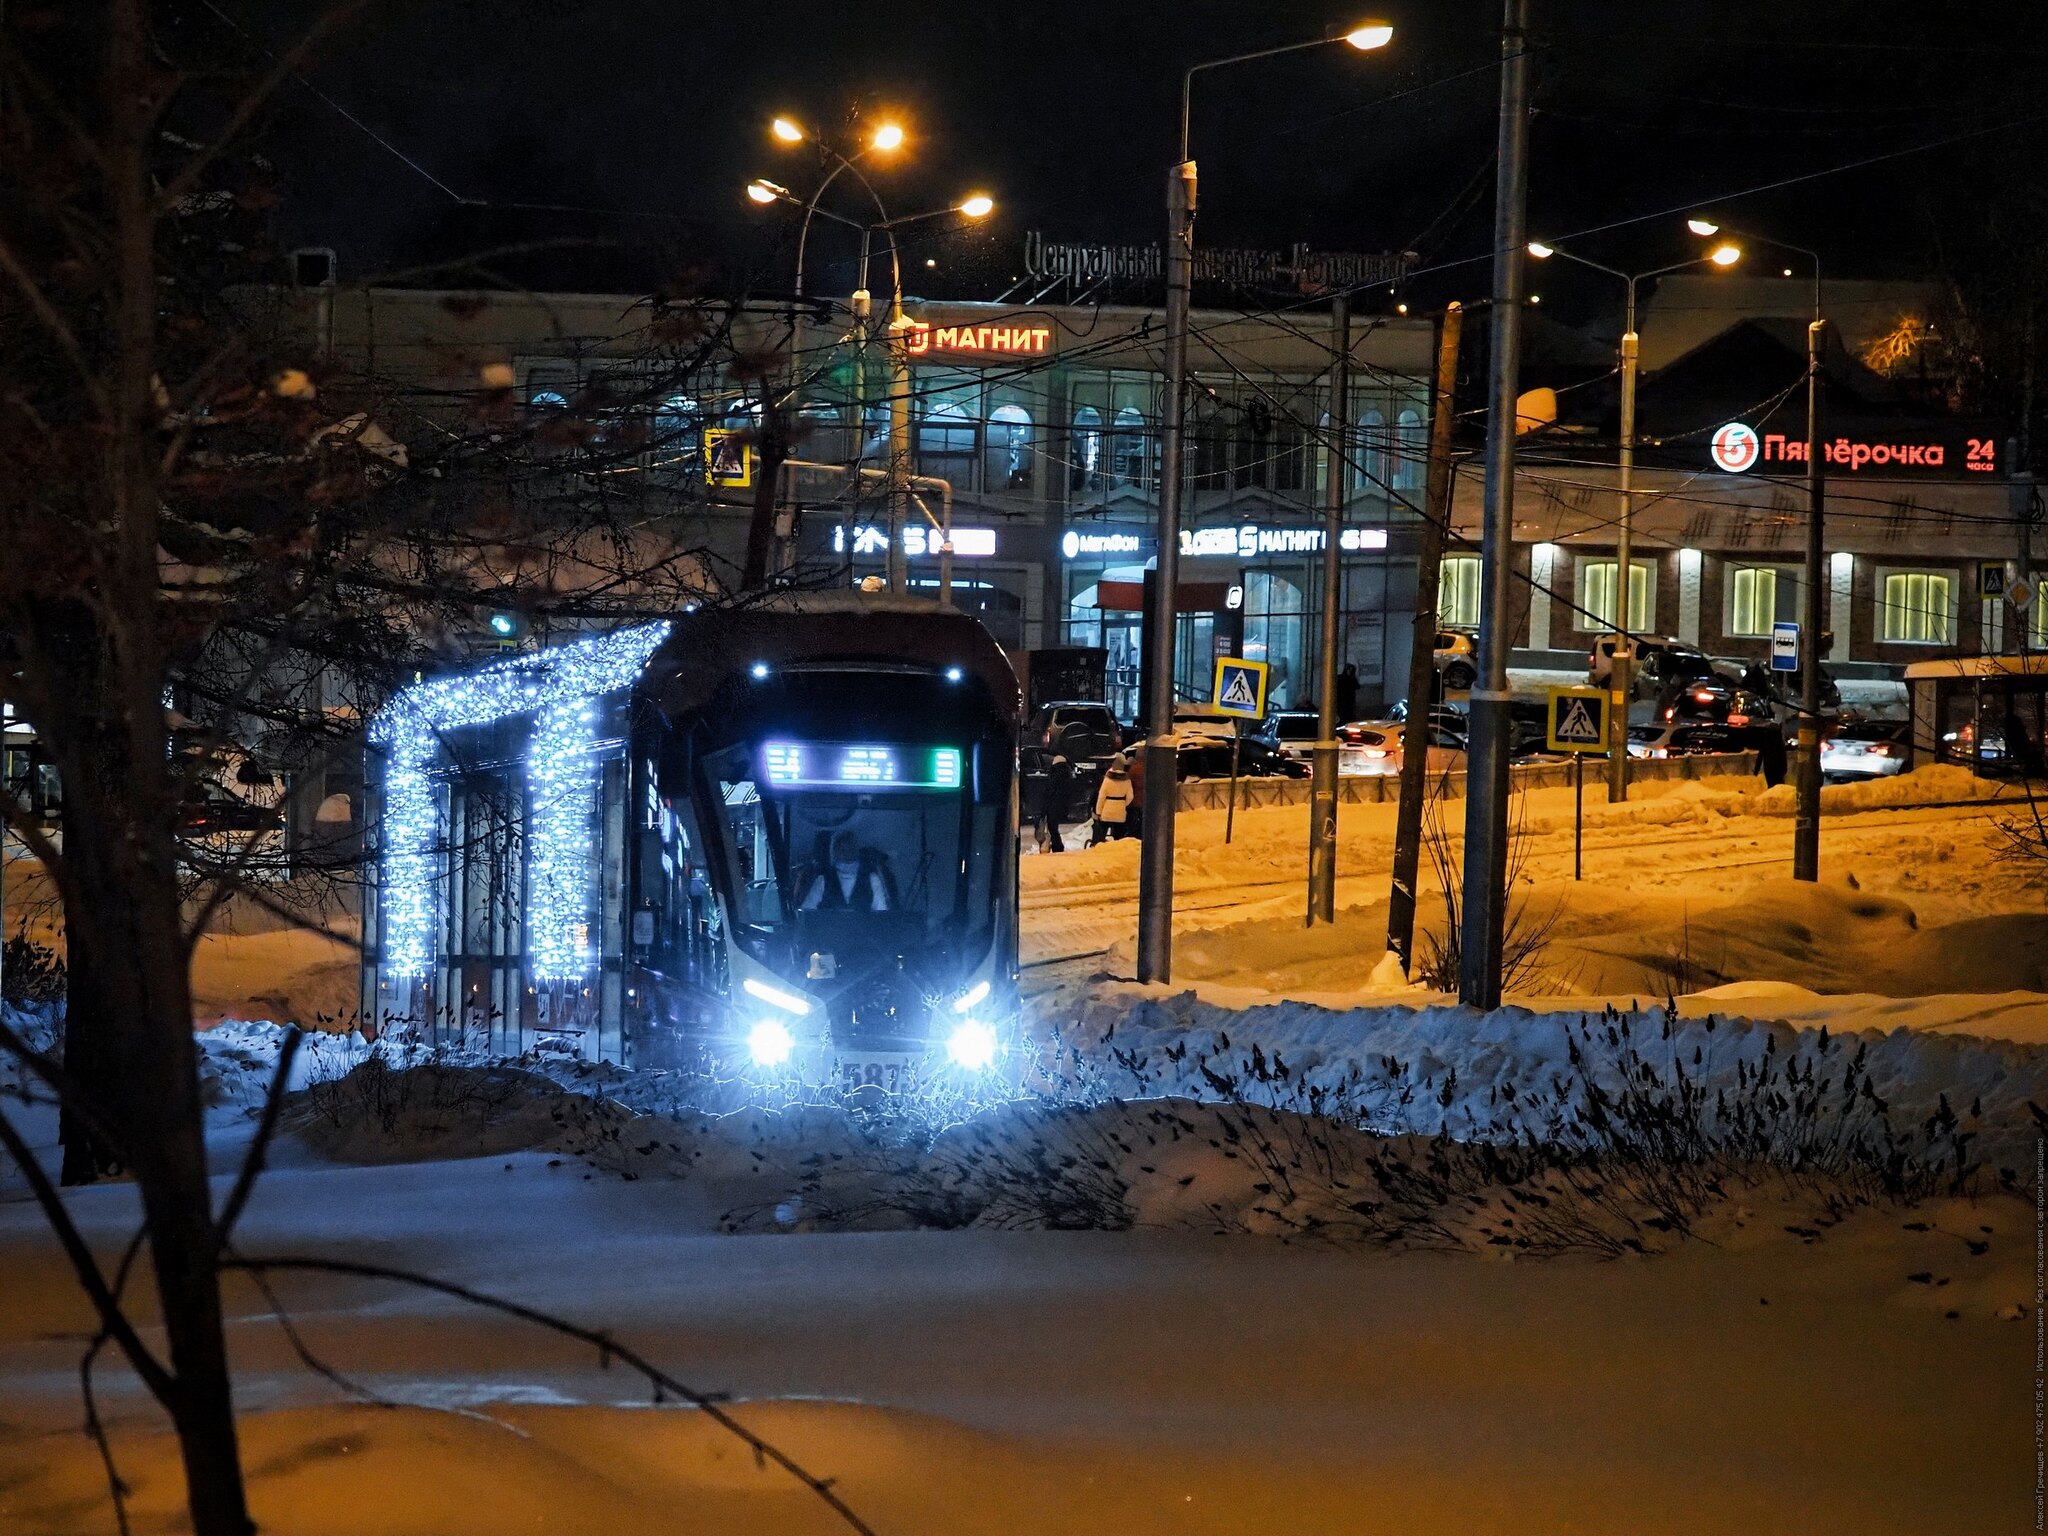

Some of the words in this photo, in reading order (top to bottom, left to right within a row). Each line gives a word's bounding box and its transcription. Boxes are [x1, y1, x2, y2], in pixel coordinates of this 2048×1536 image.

[936, 327, 1050, 351] МАГНИТ
[1966, 439, 1996, 460] 24
[1966, 462, 1995, 472] часа
[1259, 530, 1320, 552] МАГНИТ
